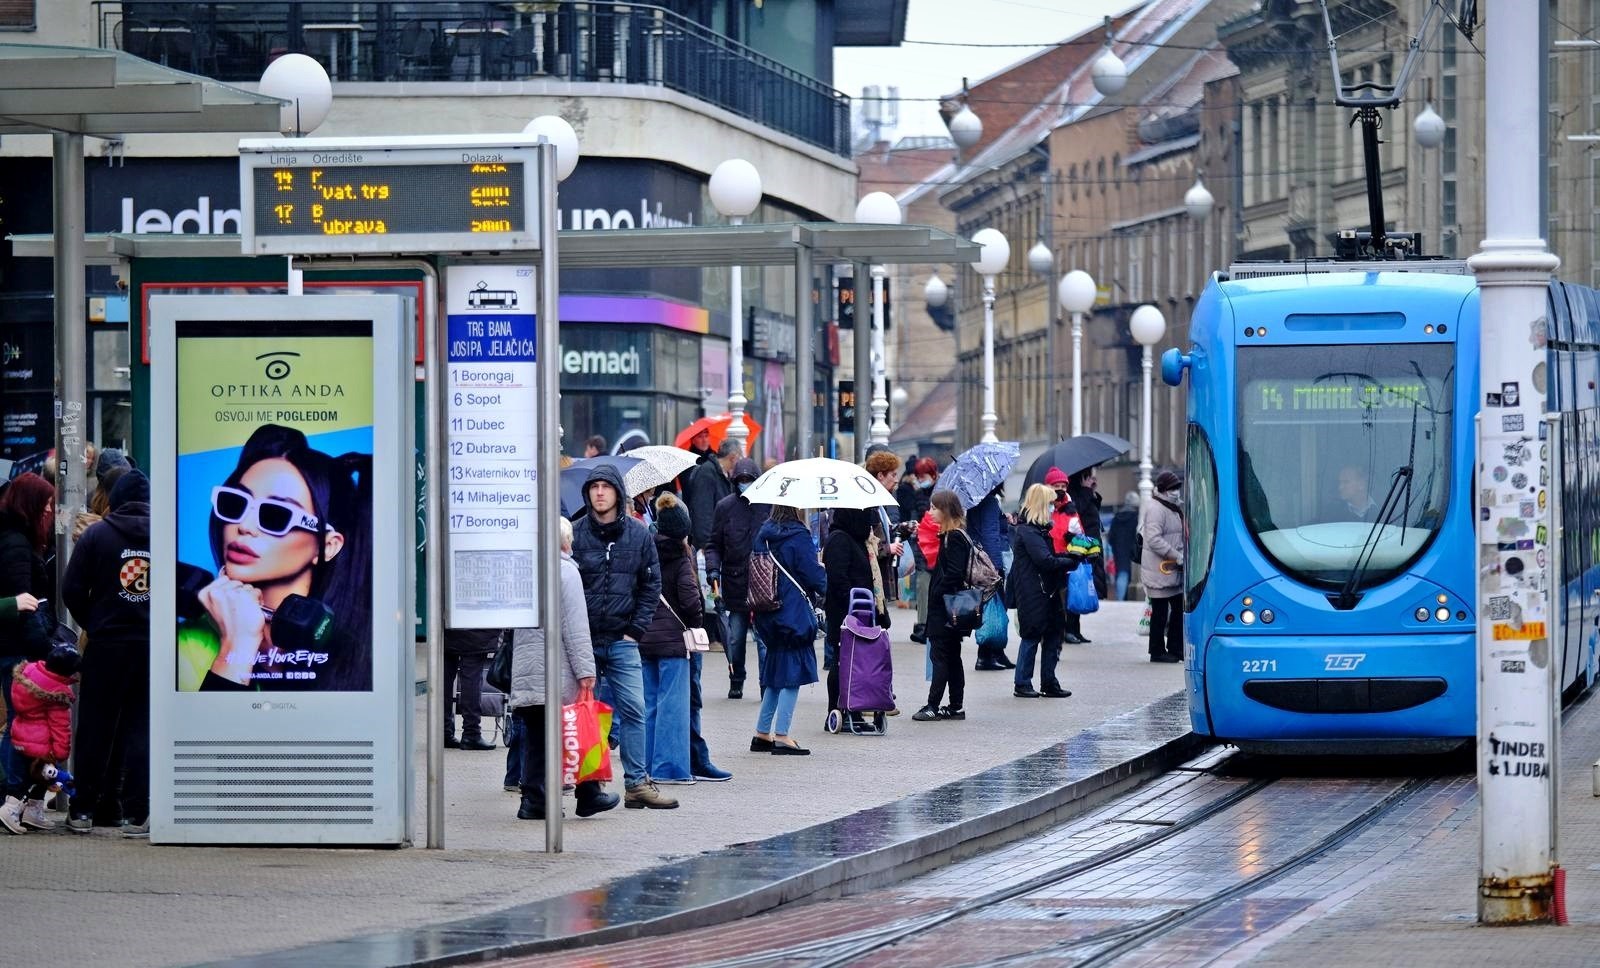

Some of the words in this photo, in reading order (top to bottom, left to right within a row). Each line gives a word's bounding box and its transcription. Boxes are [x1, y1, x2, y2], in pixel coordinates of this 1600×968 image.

[270, 155, 297, 166] Linija
[313, 153, 363, 164] Odredište
[462, 153, 504, 163] Dolazak
[361, 184, 390, 200] trg
[313, 219, 387, 235] ubrava
[467, 321, 484, 337] TRG
[488, 321, 513, 337] BANA
[450, 341, 483, 357] JOSIPA
[488, 338, 535, 357] JELAČIĆA
[452, 369, 458, 382] 1
[461, 370, 514, 384] Borongaj
[211, 384, 282, 398] OPTIKA
[291, 384, 345, 397] ANDA
[1262, 387, 1283, 410] 14
[454, 392, 463, 407] 6
[467, 393, 502, 408] Sopot
[215, 411, 253, 422] OSVOJI
[257, 411, 273, 422] ME
[276, 411, 338, 422] POGLEDOM
[451, 418, 463, 431] 11
[467, 419, 505, 431] Dubec
[450, 441, 463, 456] 12
[466, 442, 517, 454] Dubrava
[450, 466, 464, 480] 13
[465, 467, 521, 479] Kvaternikov
[524, 468, 537, 481] trg
[451, 490, 464, 504] 14
[468, 491, 532, 505] Mihaljevac
[450, 514, 464, 529] 17
[466, 515, 519, 530] Borongaj
[1242, 659, 1277, 673] 2271
[1324, 653, 1366, 671] ZET
[1489, 736, 1545, 758] TINDER
[1503, 761, 1550, 779] LJUBA
